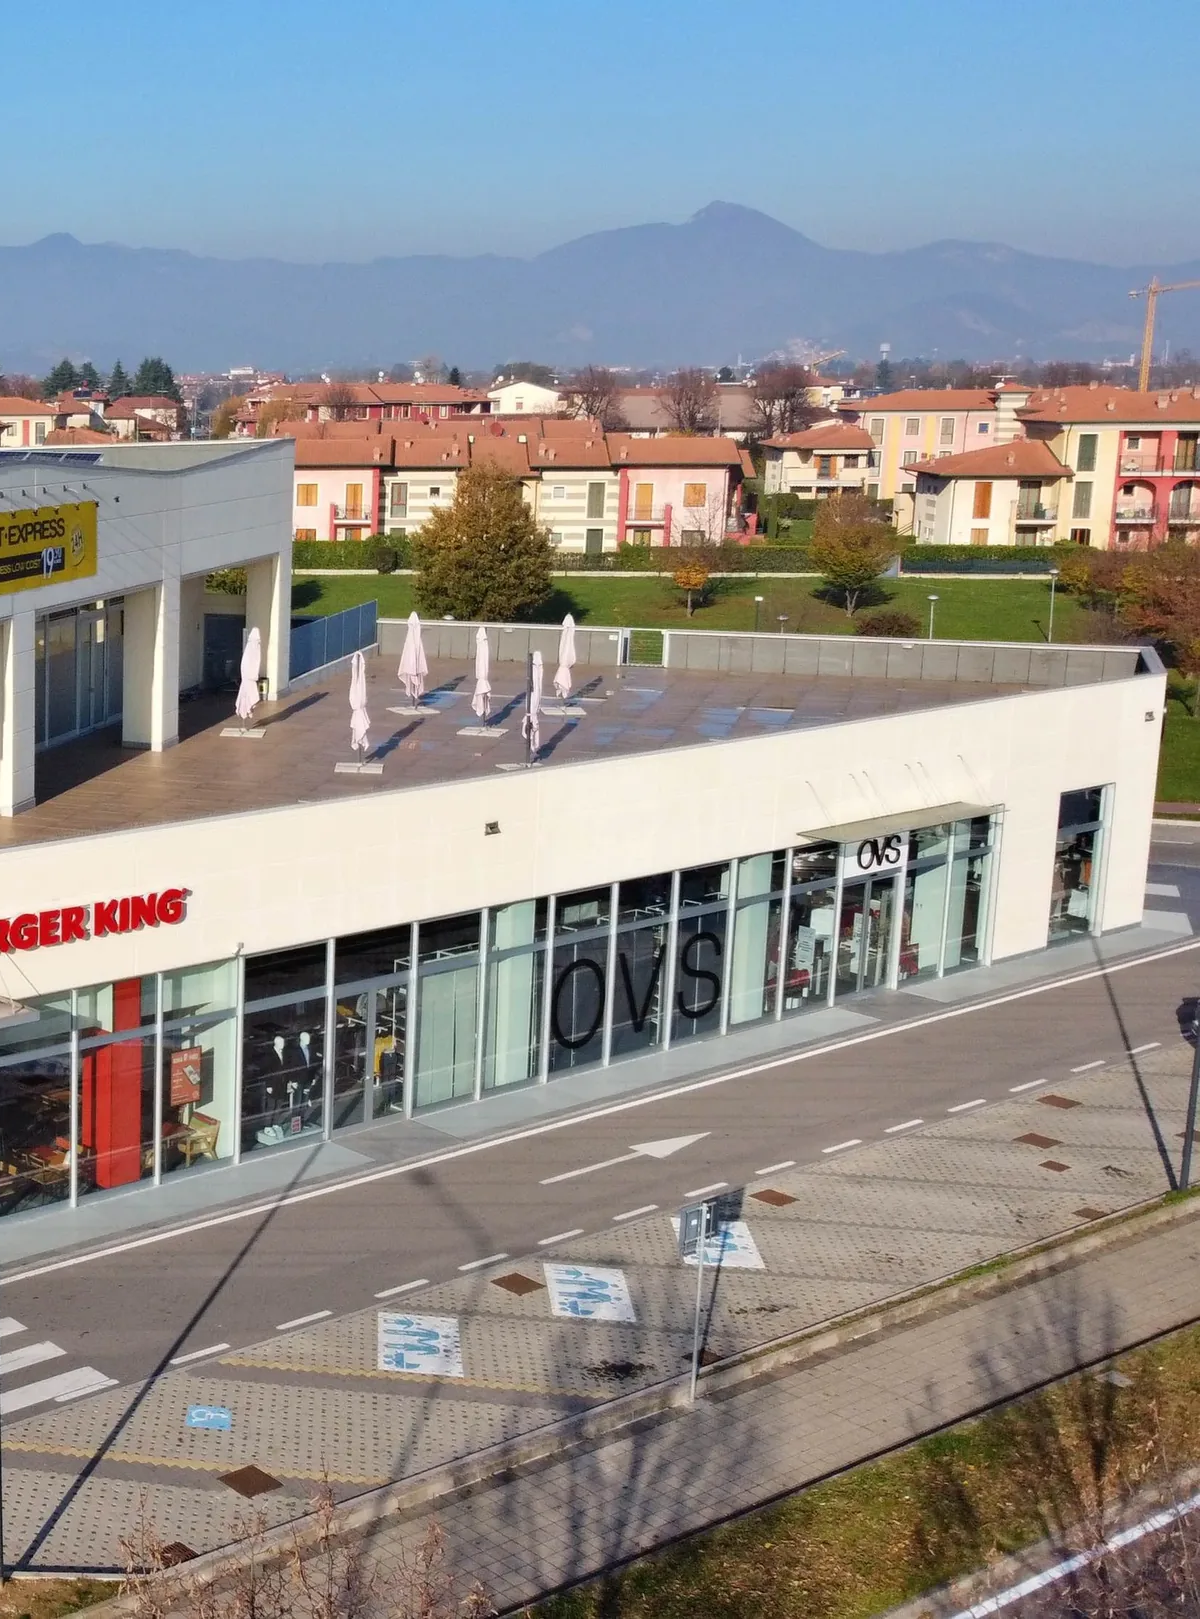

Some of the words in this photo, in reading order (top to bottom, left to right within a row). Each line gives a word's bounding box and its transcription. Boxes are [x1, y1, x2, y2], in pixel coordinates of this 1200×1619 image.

[857, 835, 902, 870] OVS
[94, 888, 188, 937] KING
[552, 932, 722, 1049] OVS
